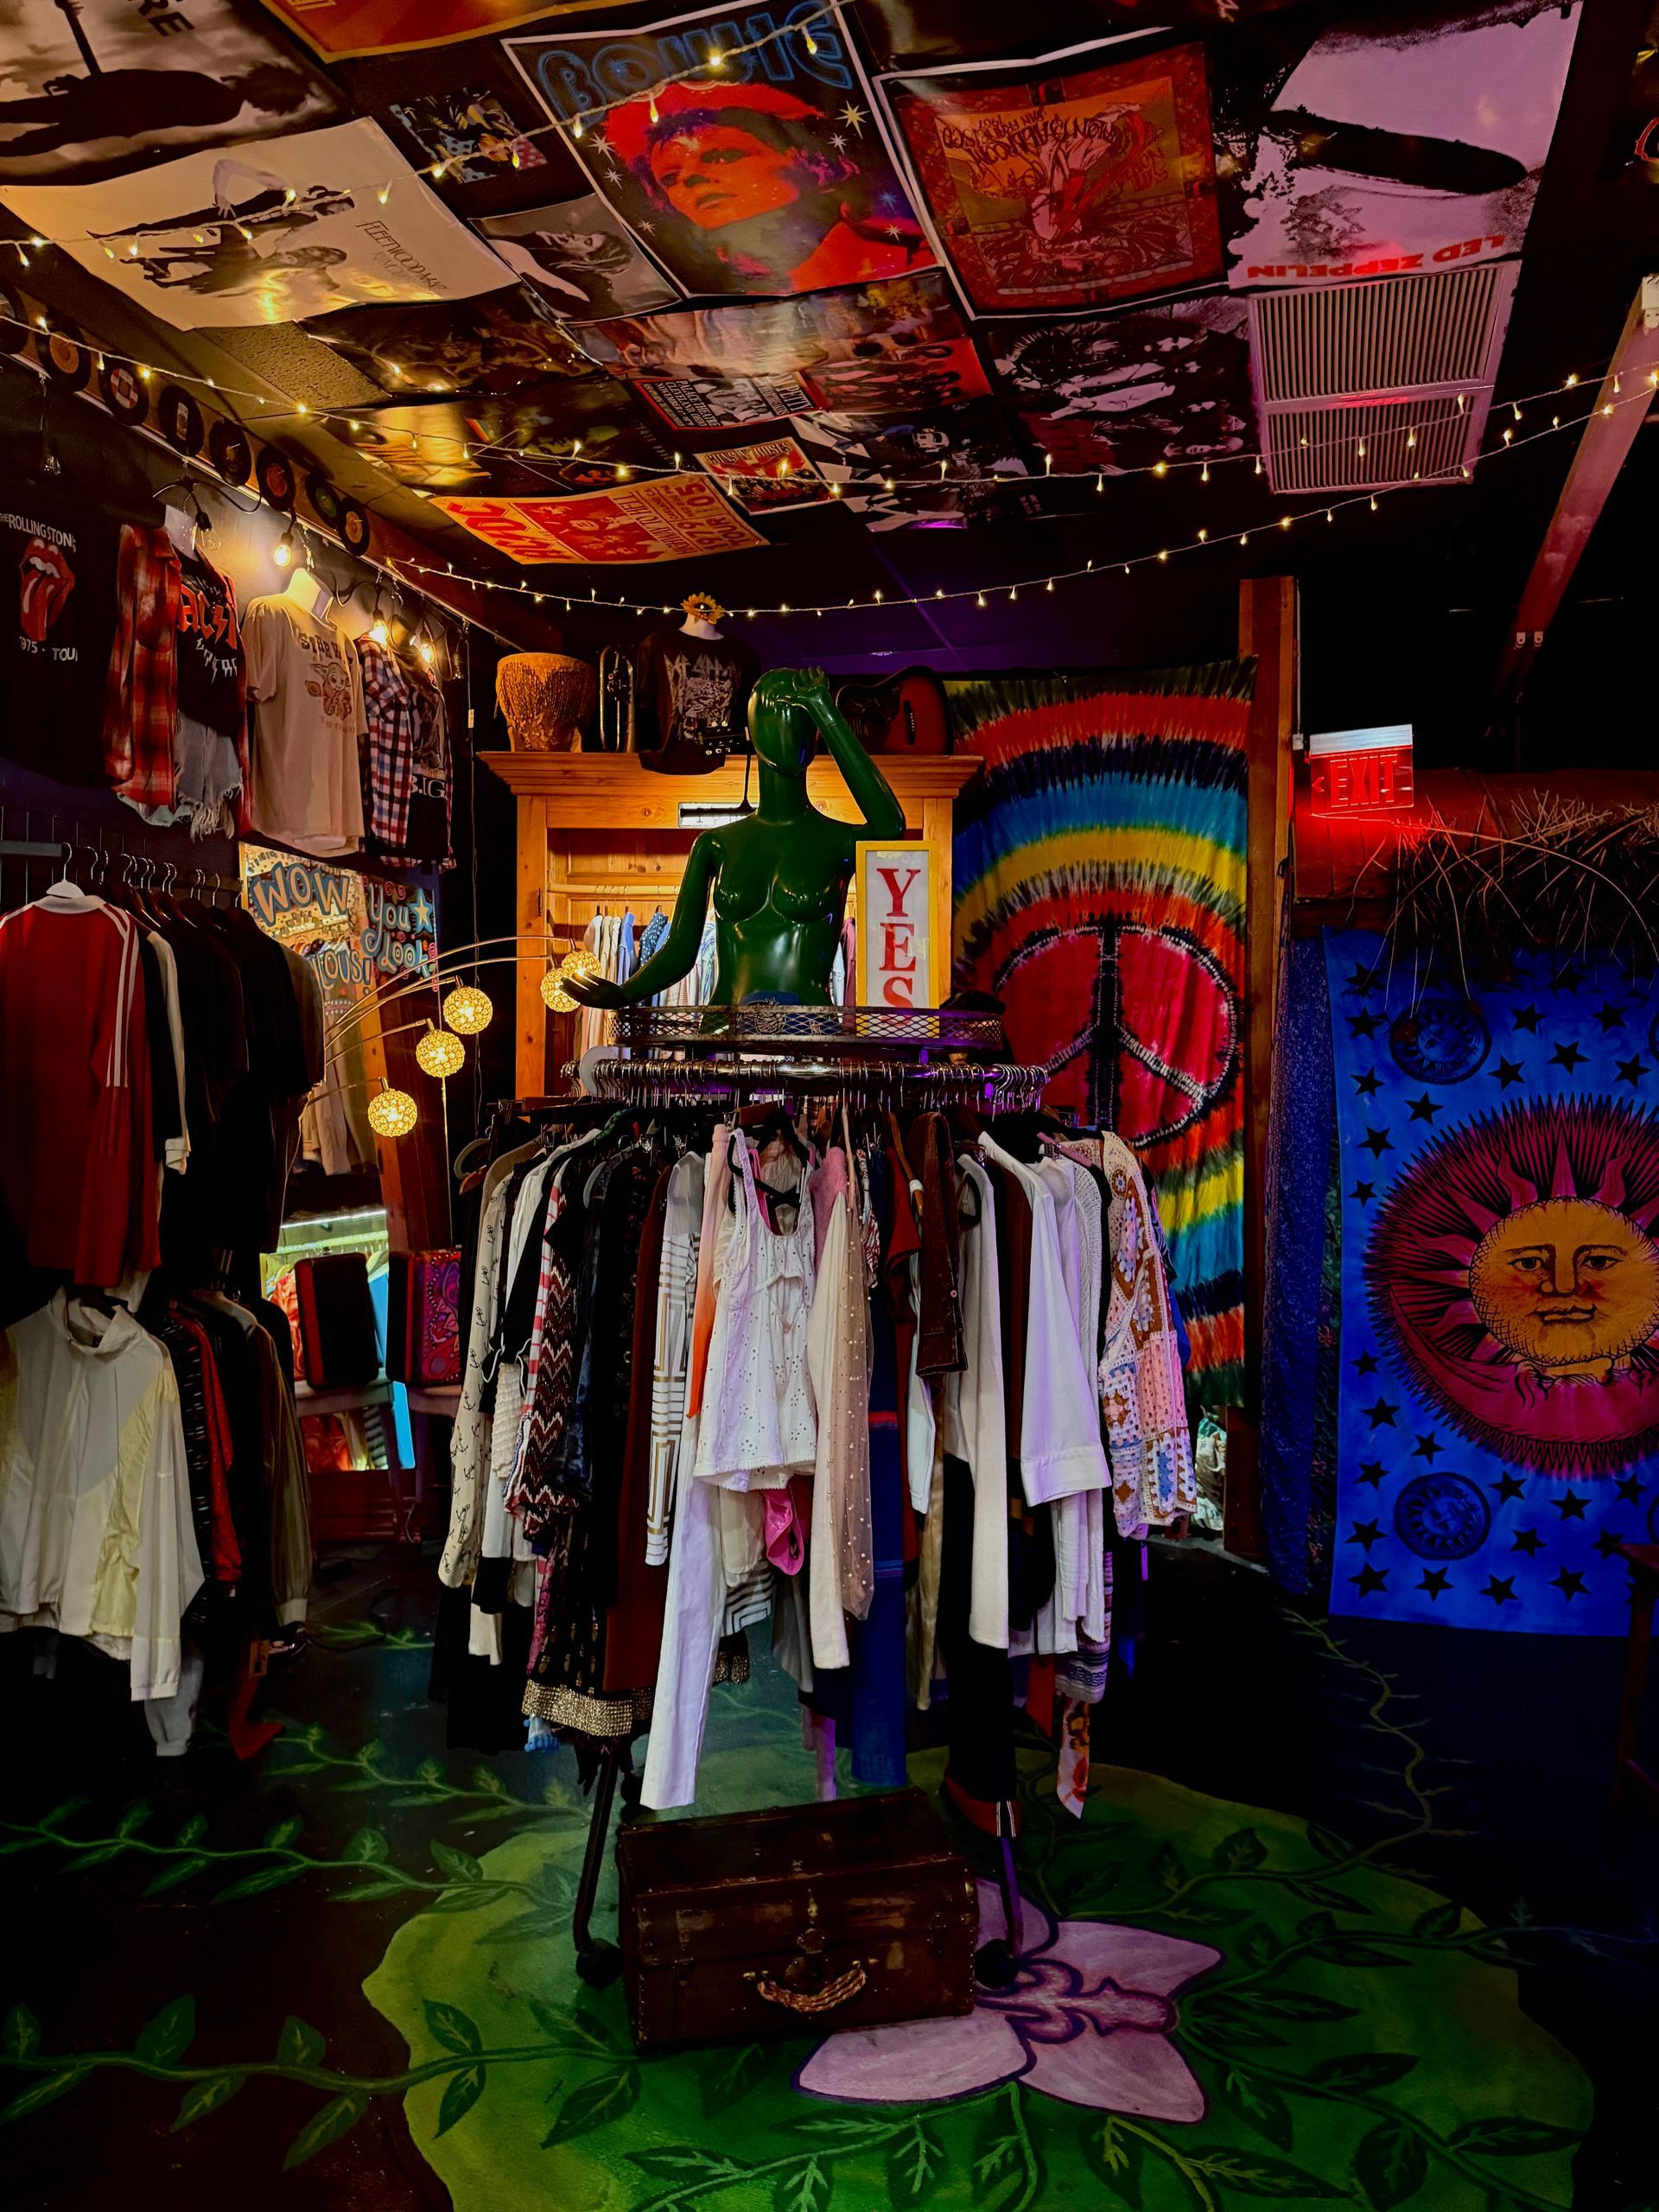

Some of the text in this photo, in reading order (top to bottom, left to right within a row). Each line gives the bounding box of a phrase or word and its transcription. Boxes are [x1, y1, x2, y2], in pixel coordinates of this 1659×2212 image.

[537, 1, 854, 132] BOWIE
[1247, 234, 1505, 278] LED ZEPPELIN
[675, 380, 702, 402] PALACE
[693, 401, 721, 427] THEATRE
[776, 385, 814, 411] PETTY
[613, 492, 652, 517] HELL
[675, 483, 716, 507] 05
[9, 513, 47, 538] ROLLING
[636, 516, 663, 527] TO
[677, 521, 730, 550] 1979
[706, 517, 753, 546] TOUR
[19, 636, 38, 654] 975
[1331, 753, 1398, 808] EXIT
[250, 861, 412, 957] WOW You
[876, 868, 921, 1028] YES
